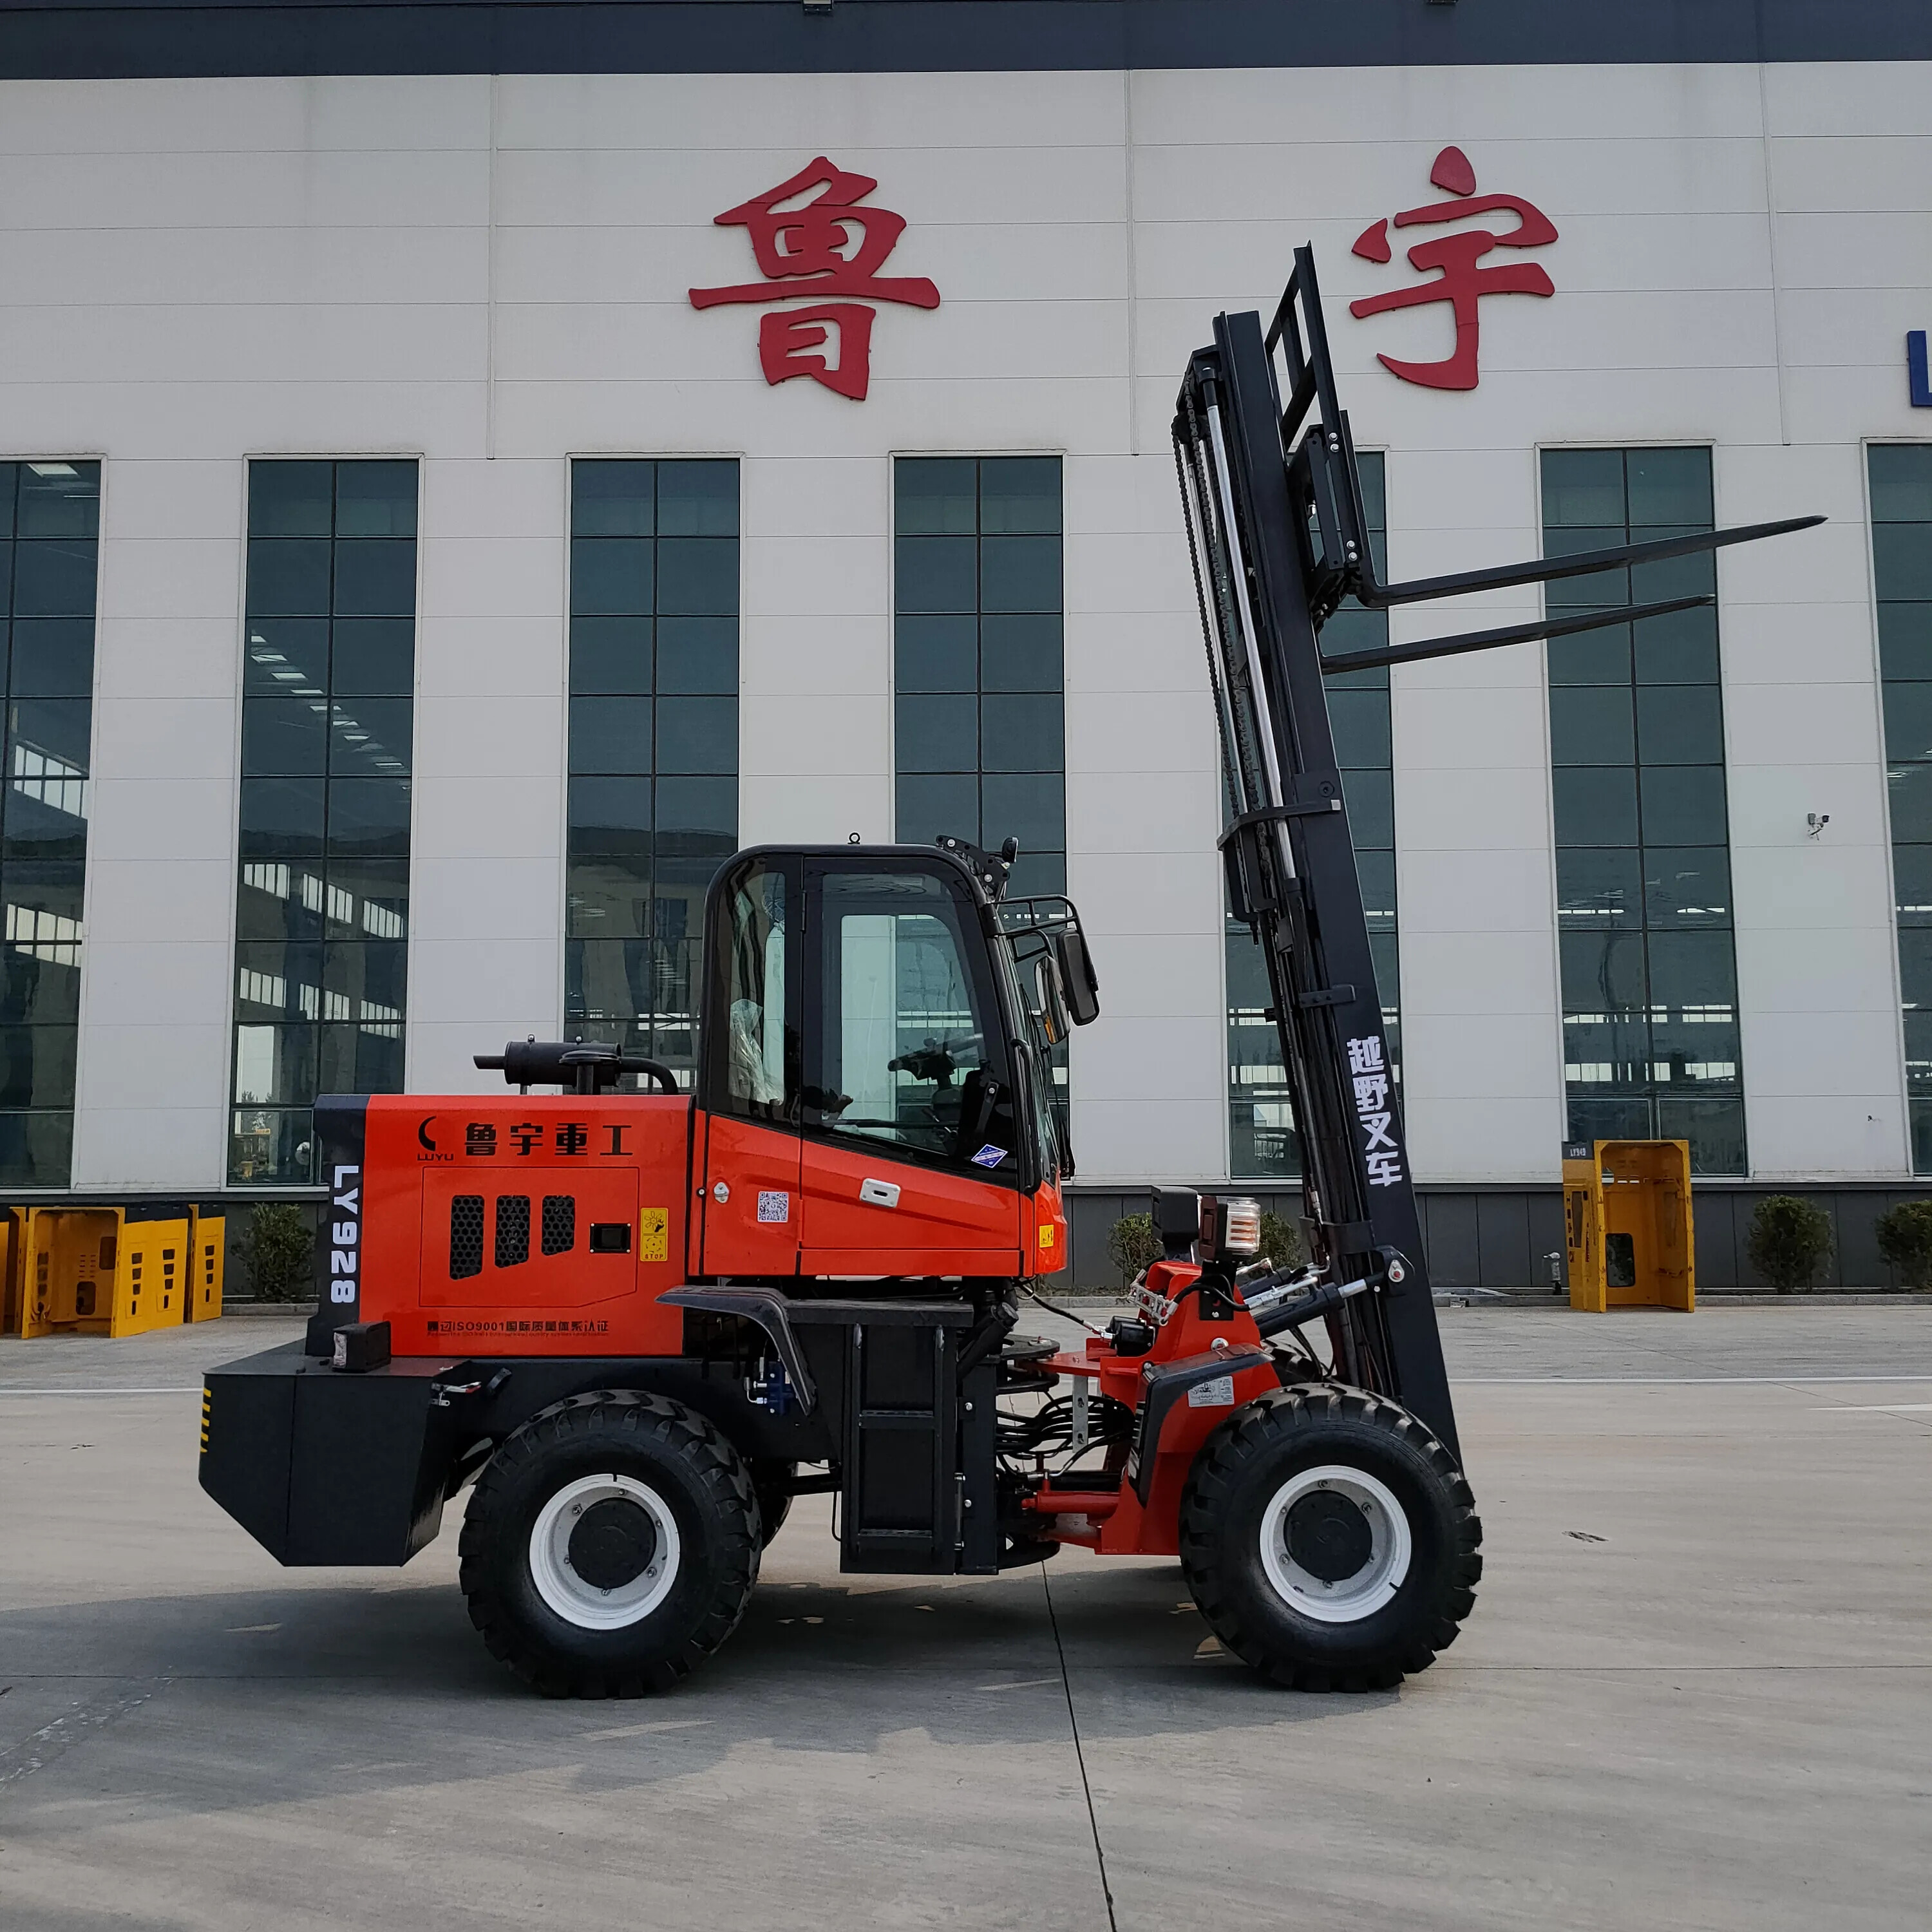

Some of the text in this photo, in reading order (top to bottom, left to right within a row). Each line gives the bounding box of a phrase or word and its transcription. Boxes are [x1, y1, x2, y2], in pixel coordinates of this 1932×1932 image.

[464, 1122, 633, 1157] 鲁宇重工
[1346, 1036, 1403, 1187] 越野叉车
[330, 1166, 359, 1303] LY928
